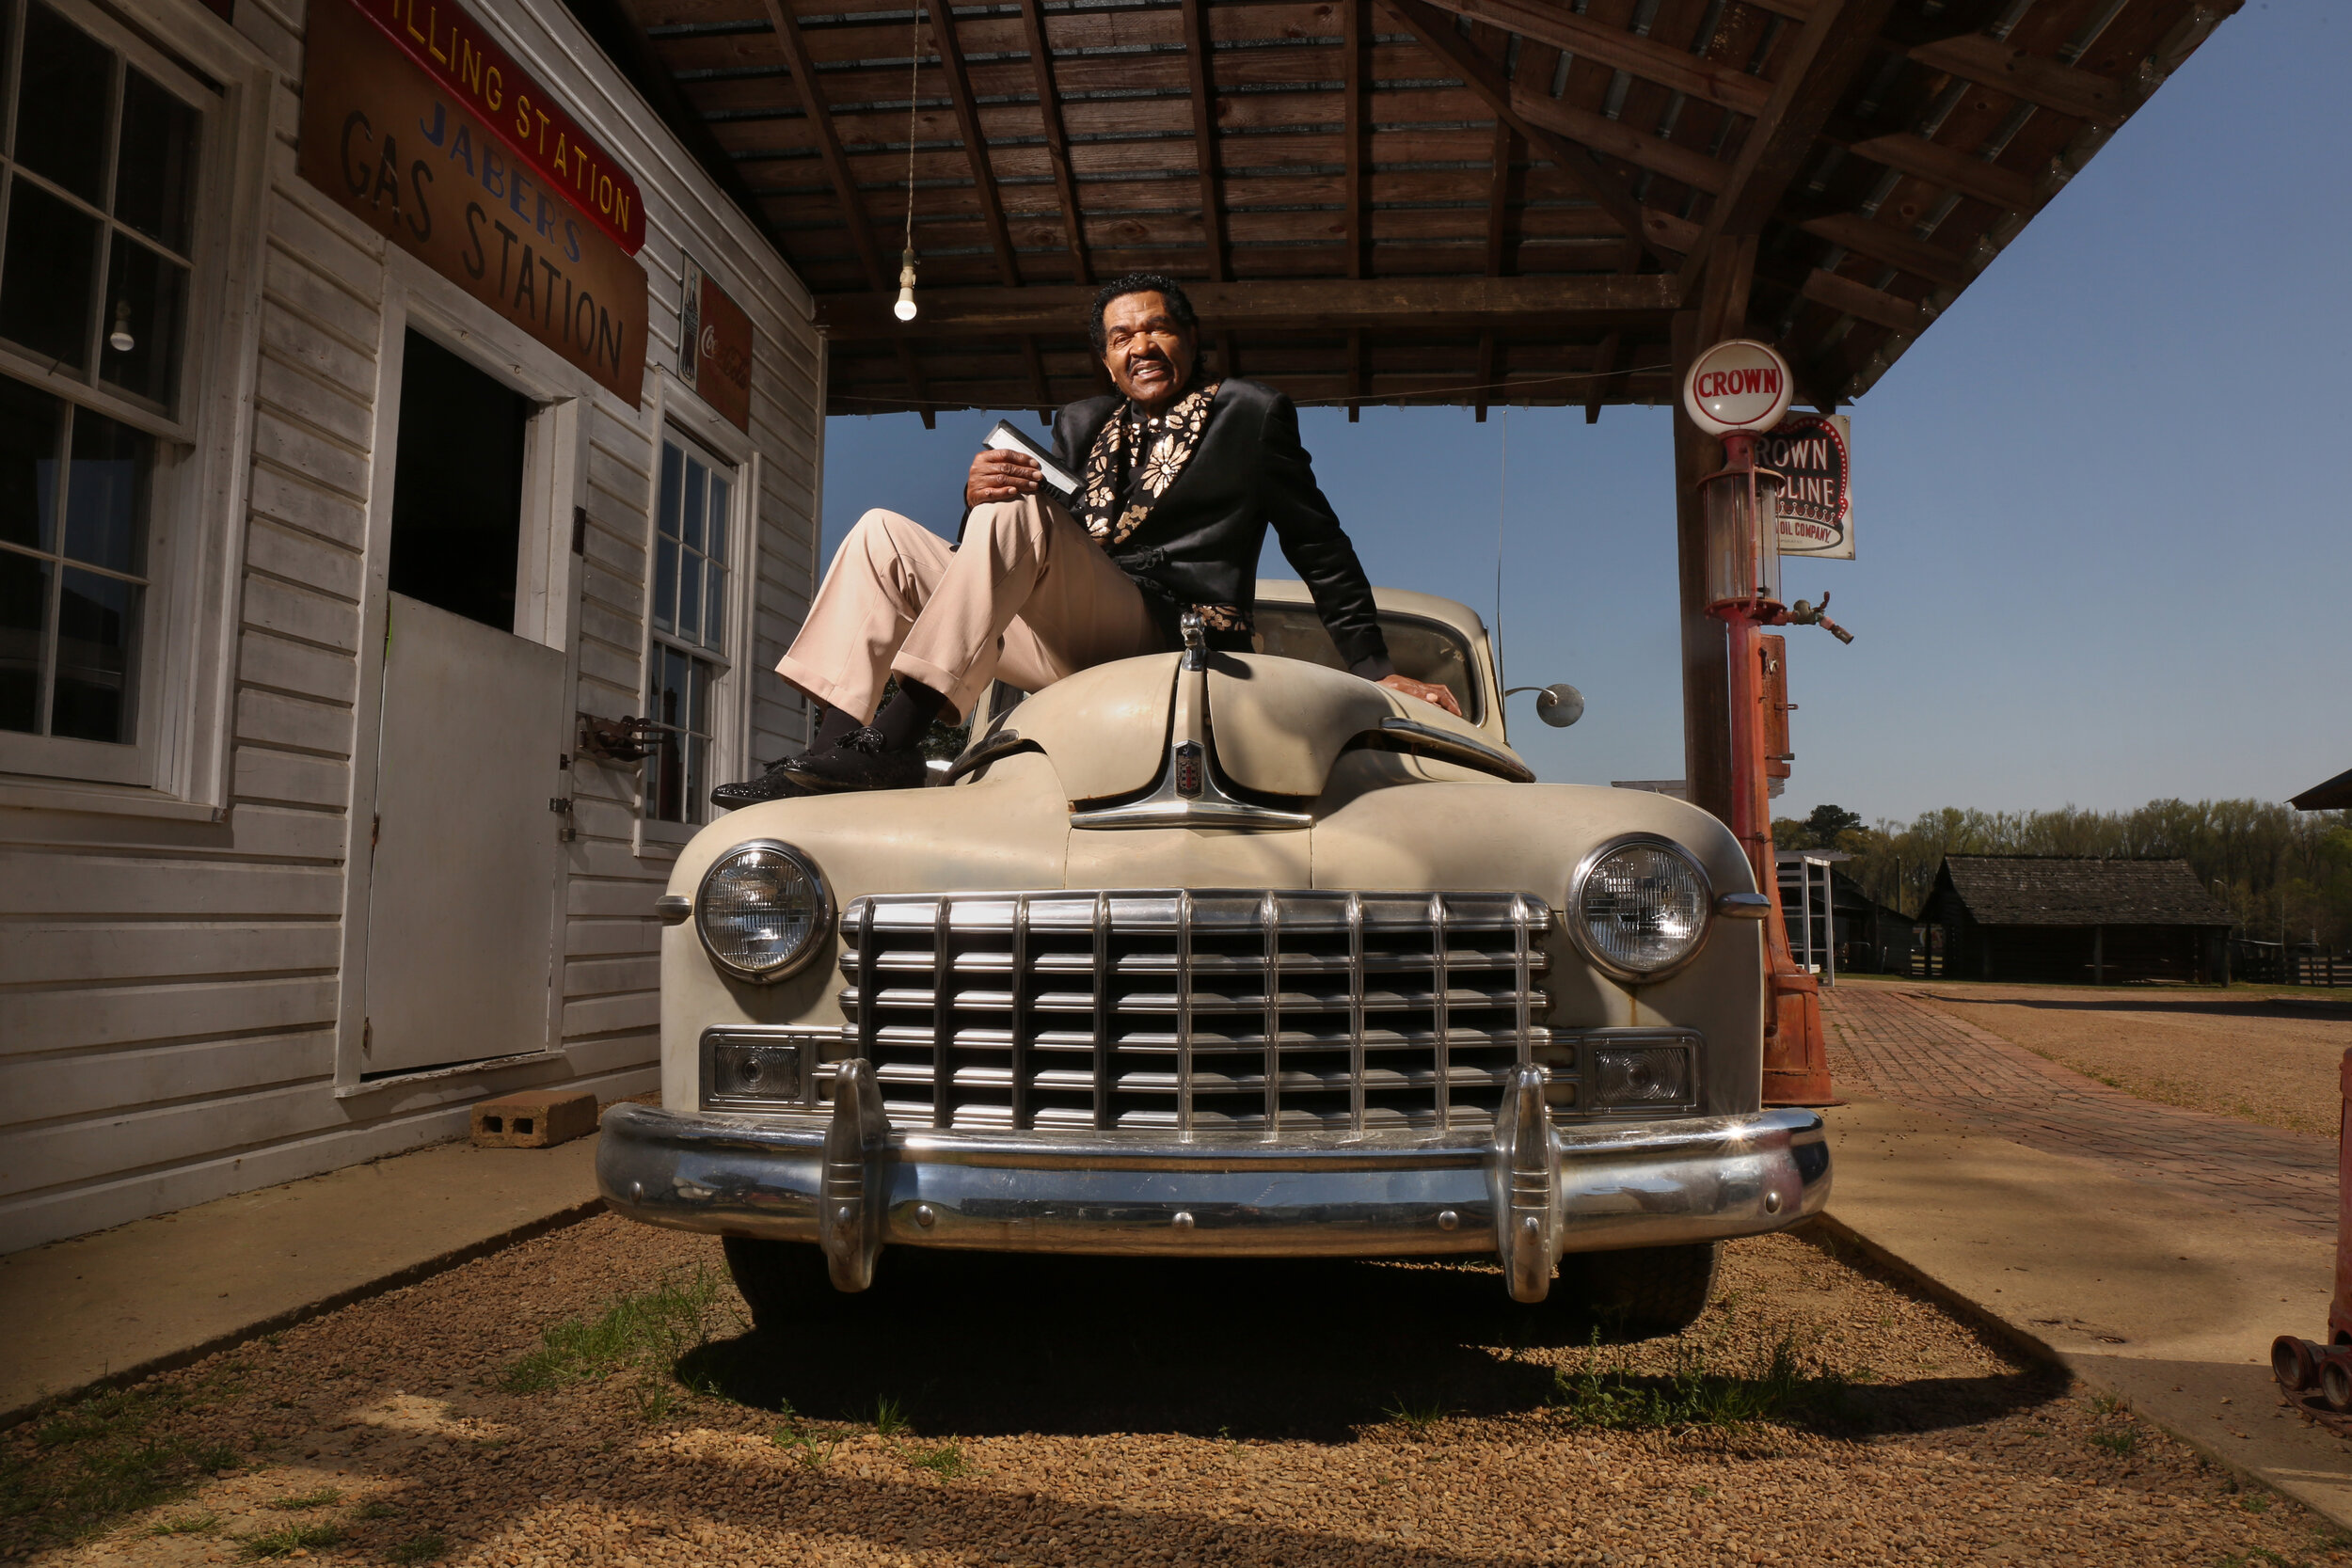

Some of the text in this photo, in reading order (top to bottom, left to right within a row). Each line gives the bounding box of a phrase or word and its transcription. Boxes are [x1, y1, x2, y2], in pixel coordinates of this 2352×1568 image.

[420, 101, 582, 263] JABER'S
[516, 95, 630, 233] STATION
[341, 110, 625, 379] GAS STATION
[1698, 369, 1776, 398] CROWN
[1779, 521, 1793, 536] OIL
